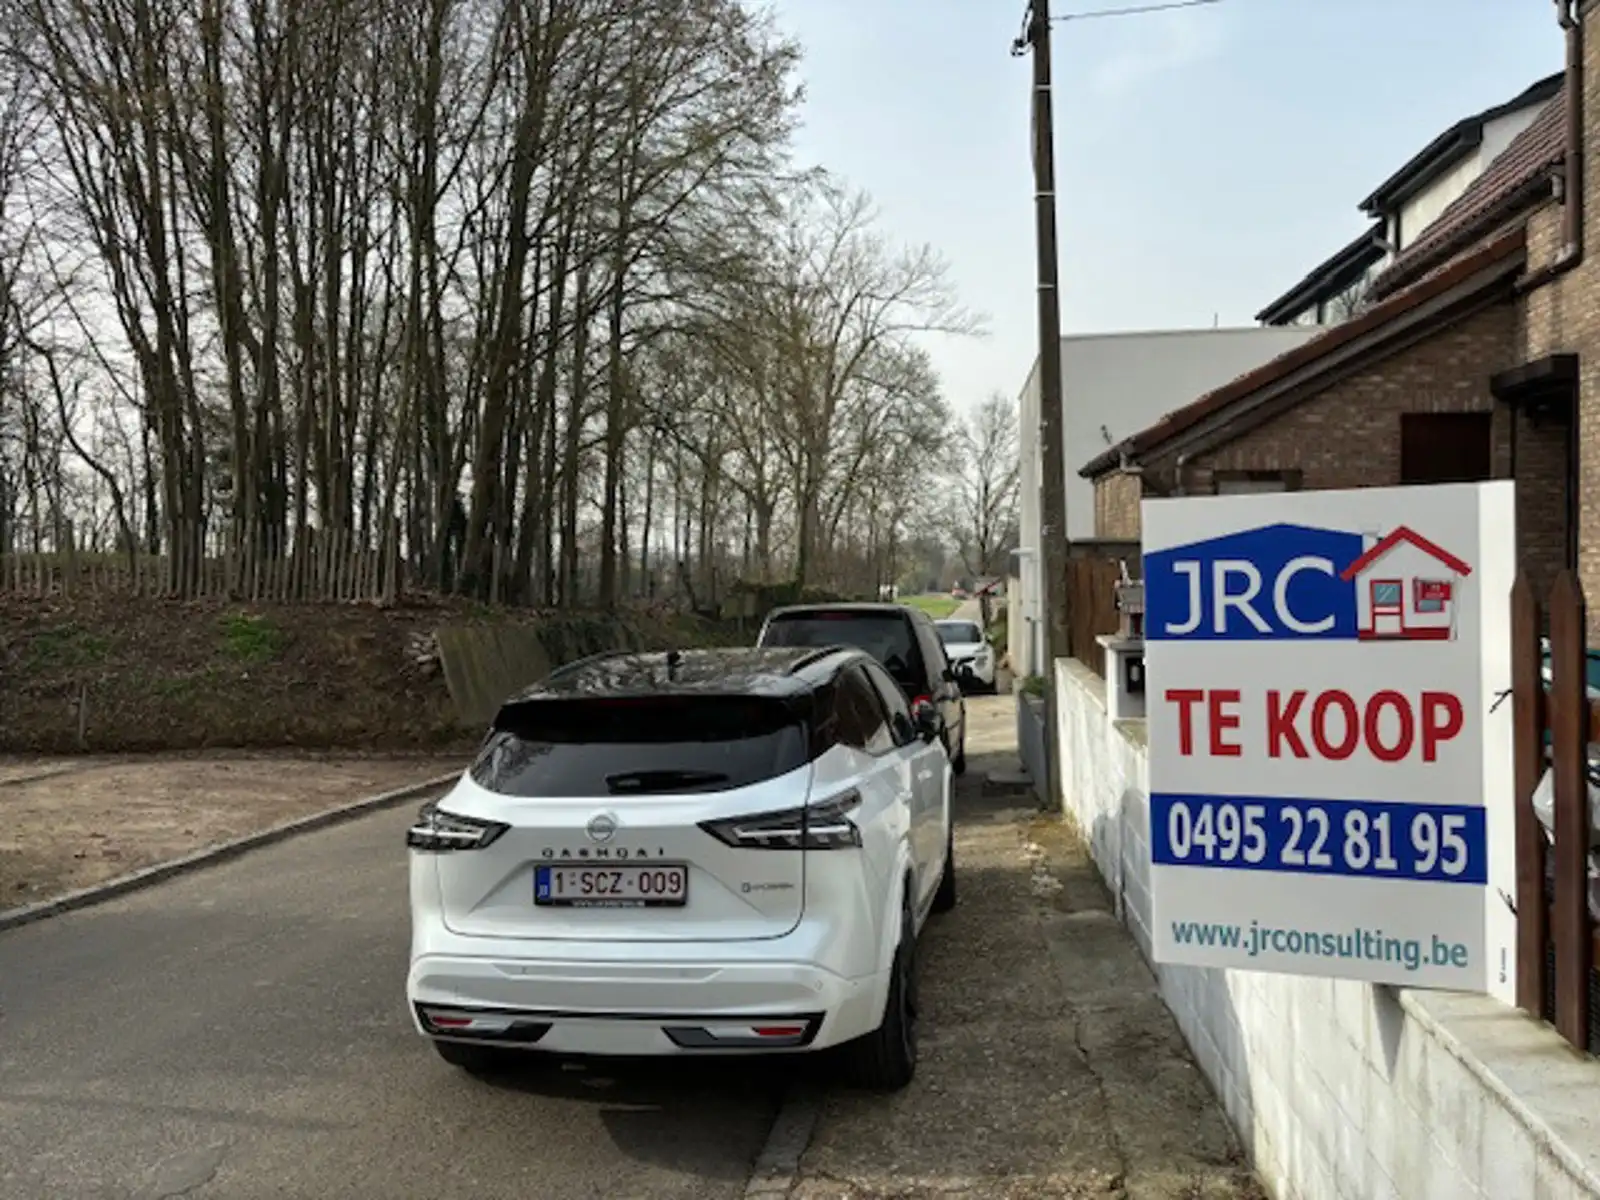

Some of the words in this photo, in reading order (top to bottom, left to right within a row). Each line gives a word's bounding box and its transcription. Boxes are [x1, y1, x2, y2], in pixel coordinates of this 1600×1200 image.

[1165, 557, 1336, 634] JRC
[1165, 689, 1242, 756] TE
[1267, 690, 1465, 763] KOOP
[541, 847, 664, 859] QASHQAI
[1168, 802, 1267, 864] 0495
[1280, 807, 1332, 867] 22
[1344, 809, 1397, 871] 81
[1410, 813, 1467, 876] 95
[1172, 919, 1467, 969] www.jrconsulting.be
